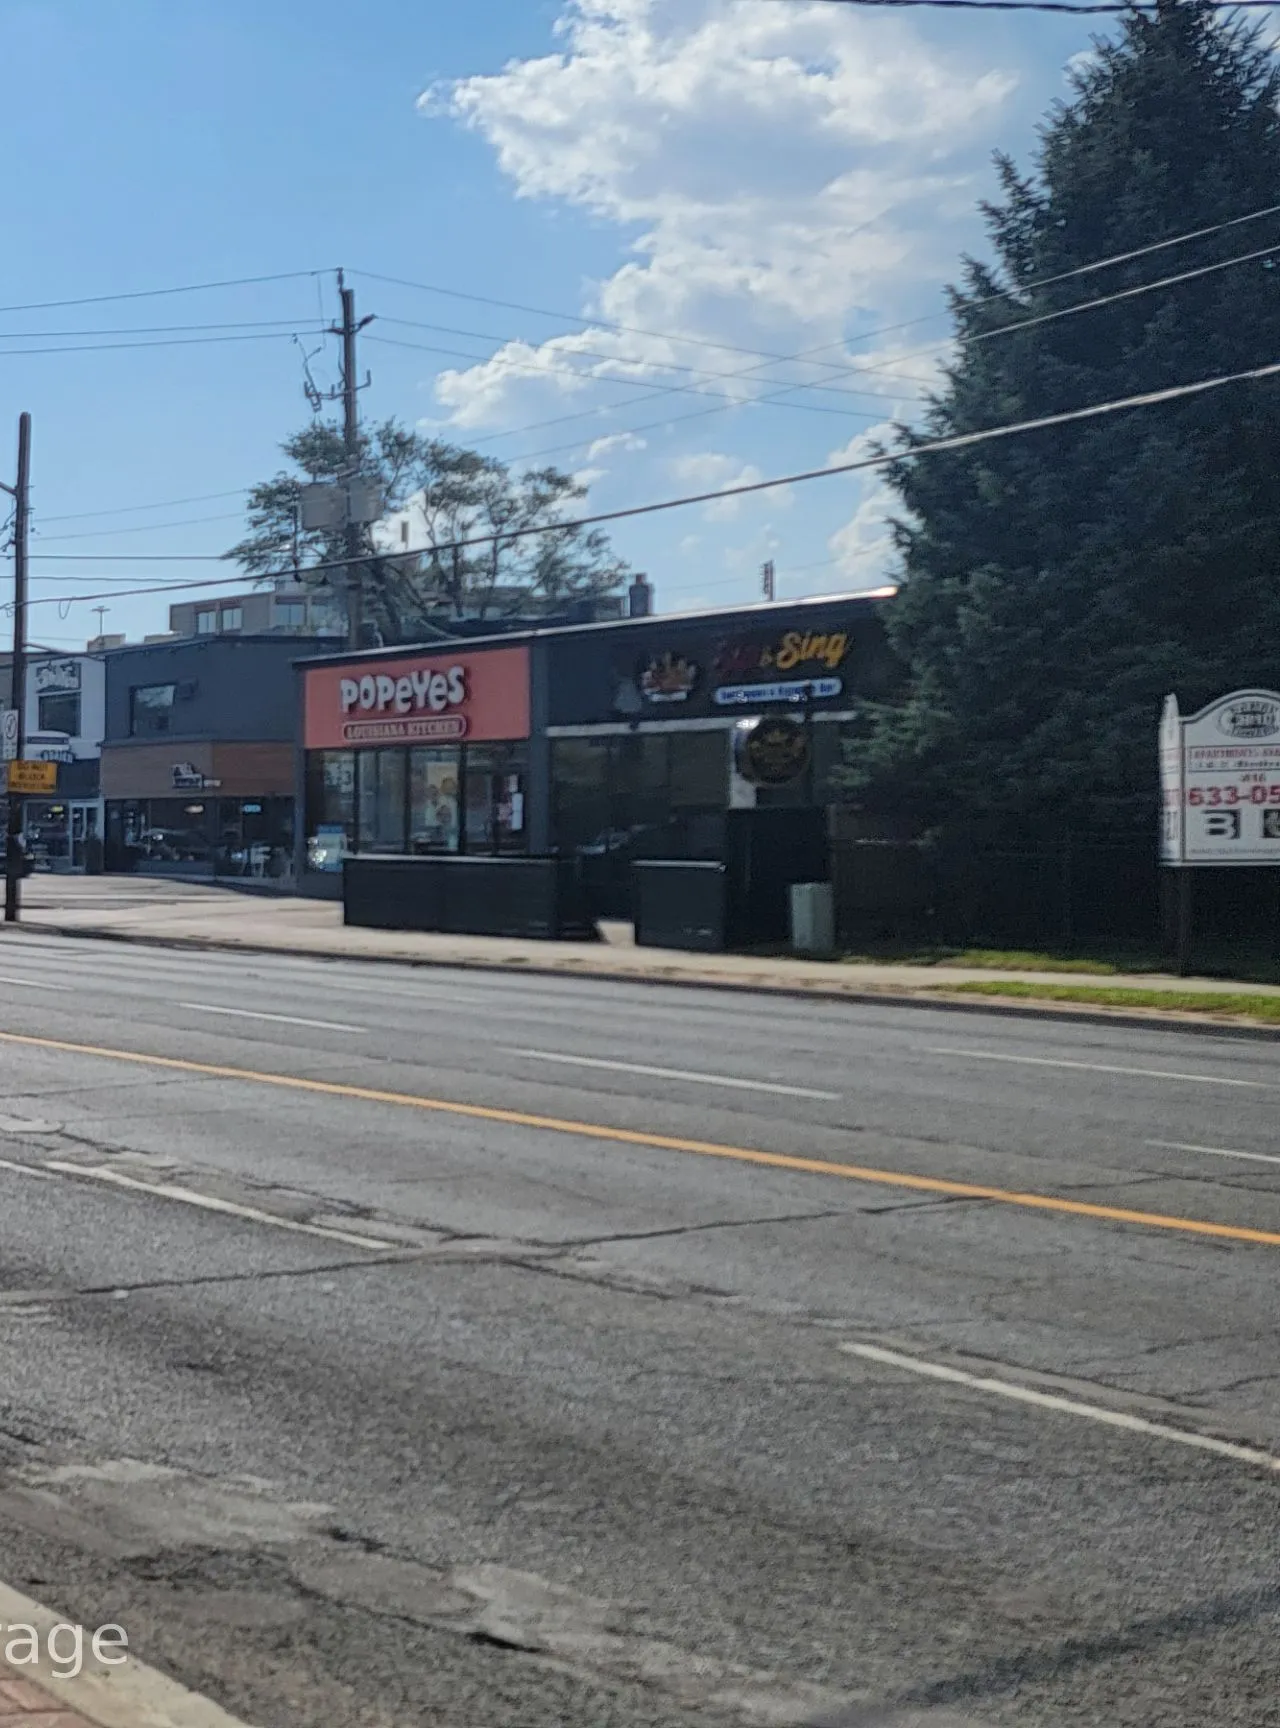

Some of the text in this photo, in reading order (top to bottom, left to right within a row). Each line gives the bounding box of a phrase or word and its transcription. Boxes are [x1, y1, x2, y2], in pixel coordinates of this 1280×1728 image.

[776, 632, 848, 669] Sing
[346, 720, 460, 740] LOUISIANA KITCHEN
